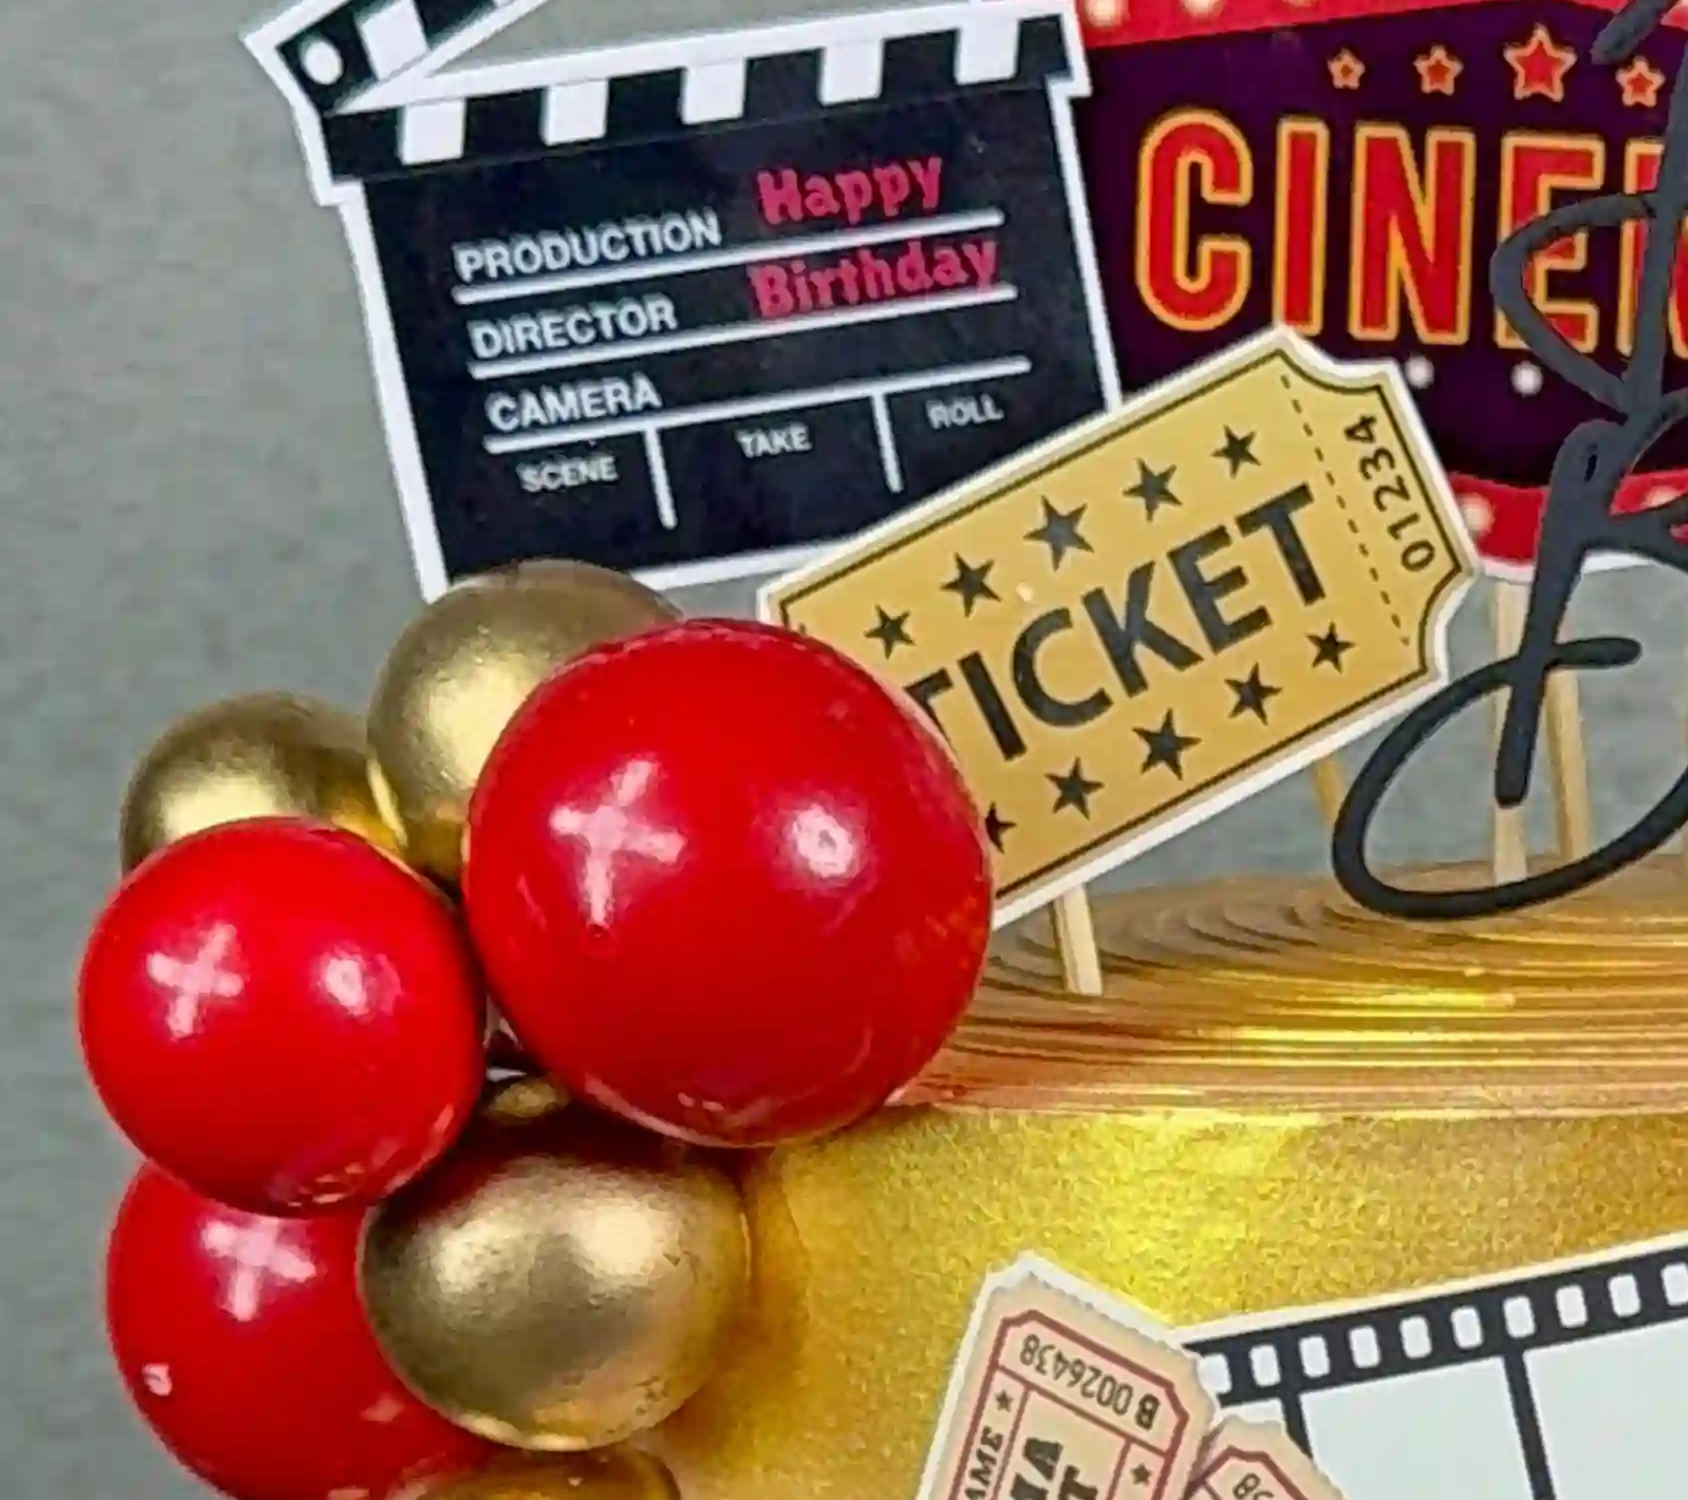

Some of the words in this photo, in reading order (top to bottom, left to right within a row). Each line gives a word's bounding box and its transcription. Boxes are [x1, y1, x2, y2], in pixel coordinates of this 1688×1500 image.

[452, 207, 722, 282] PRODUCTION
[757, 156, 943, 225] Happy
[467, 293, 678, 359] DIRECTOR
[747, 240, 997, 318] Birthday
[485, 371, 663, 432] CAMERA
[516, 454, 619, 492] SCENE
[736, 424, 812, 458] TAKE
[926, 395, 1004, 429] ROLL
[1344, 415, 1435, 572] 01234
[1135, 1393, 1160, 1431] B
